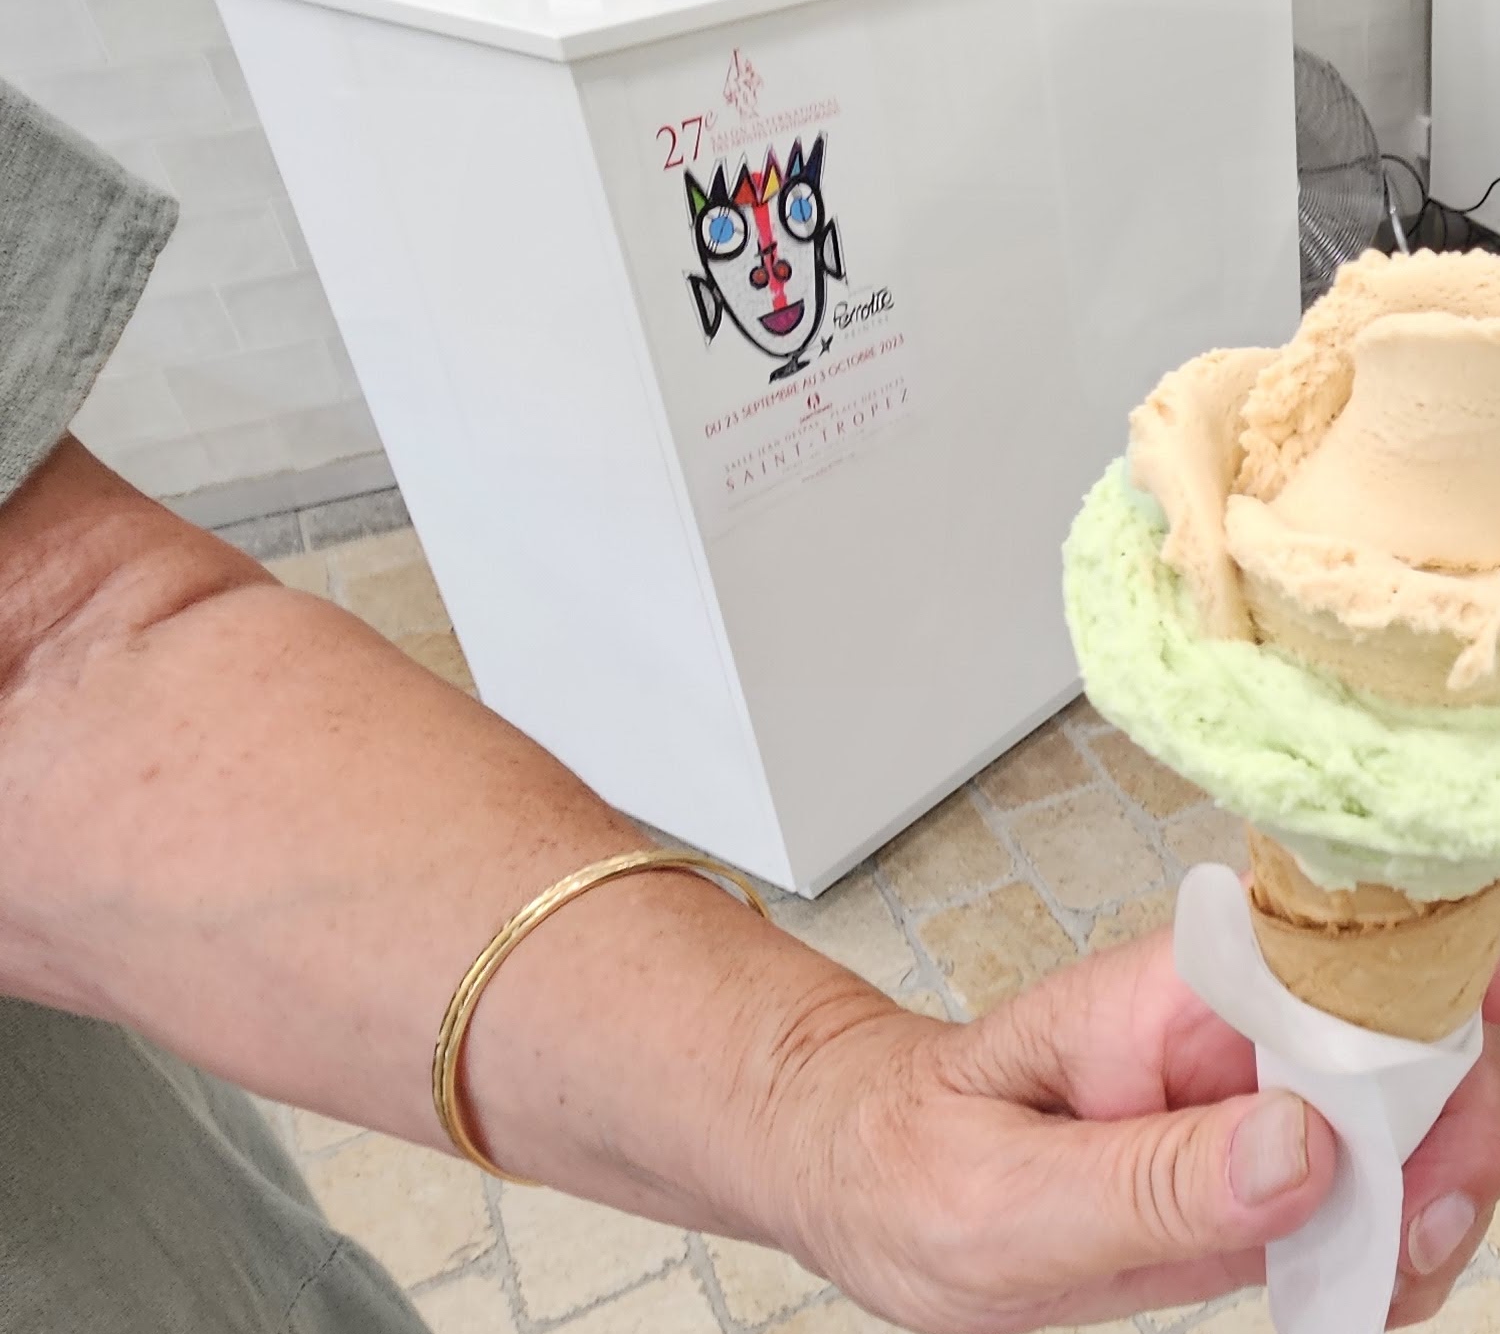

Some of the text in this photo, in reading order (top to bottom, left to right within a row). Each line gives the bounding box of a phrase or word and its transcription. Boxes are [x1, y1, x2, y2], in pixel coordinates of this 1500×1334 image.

[705, 421, 722, 439] DU
[726, 414, 739, 430] 23
[741, 382, 800, 419] SEPTEMBRE
[803, 376, 817, 391] AU
[828, 347, 875, 378] OCTOBRE
[880, 332, 905, 354] 2023
